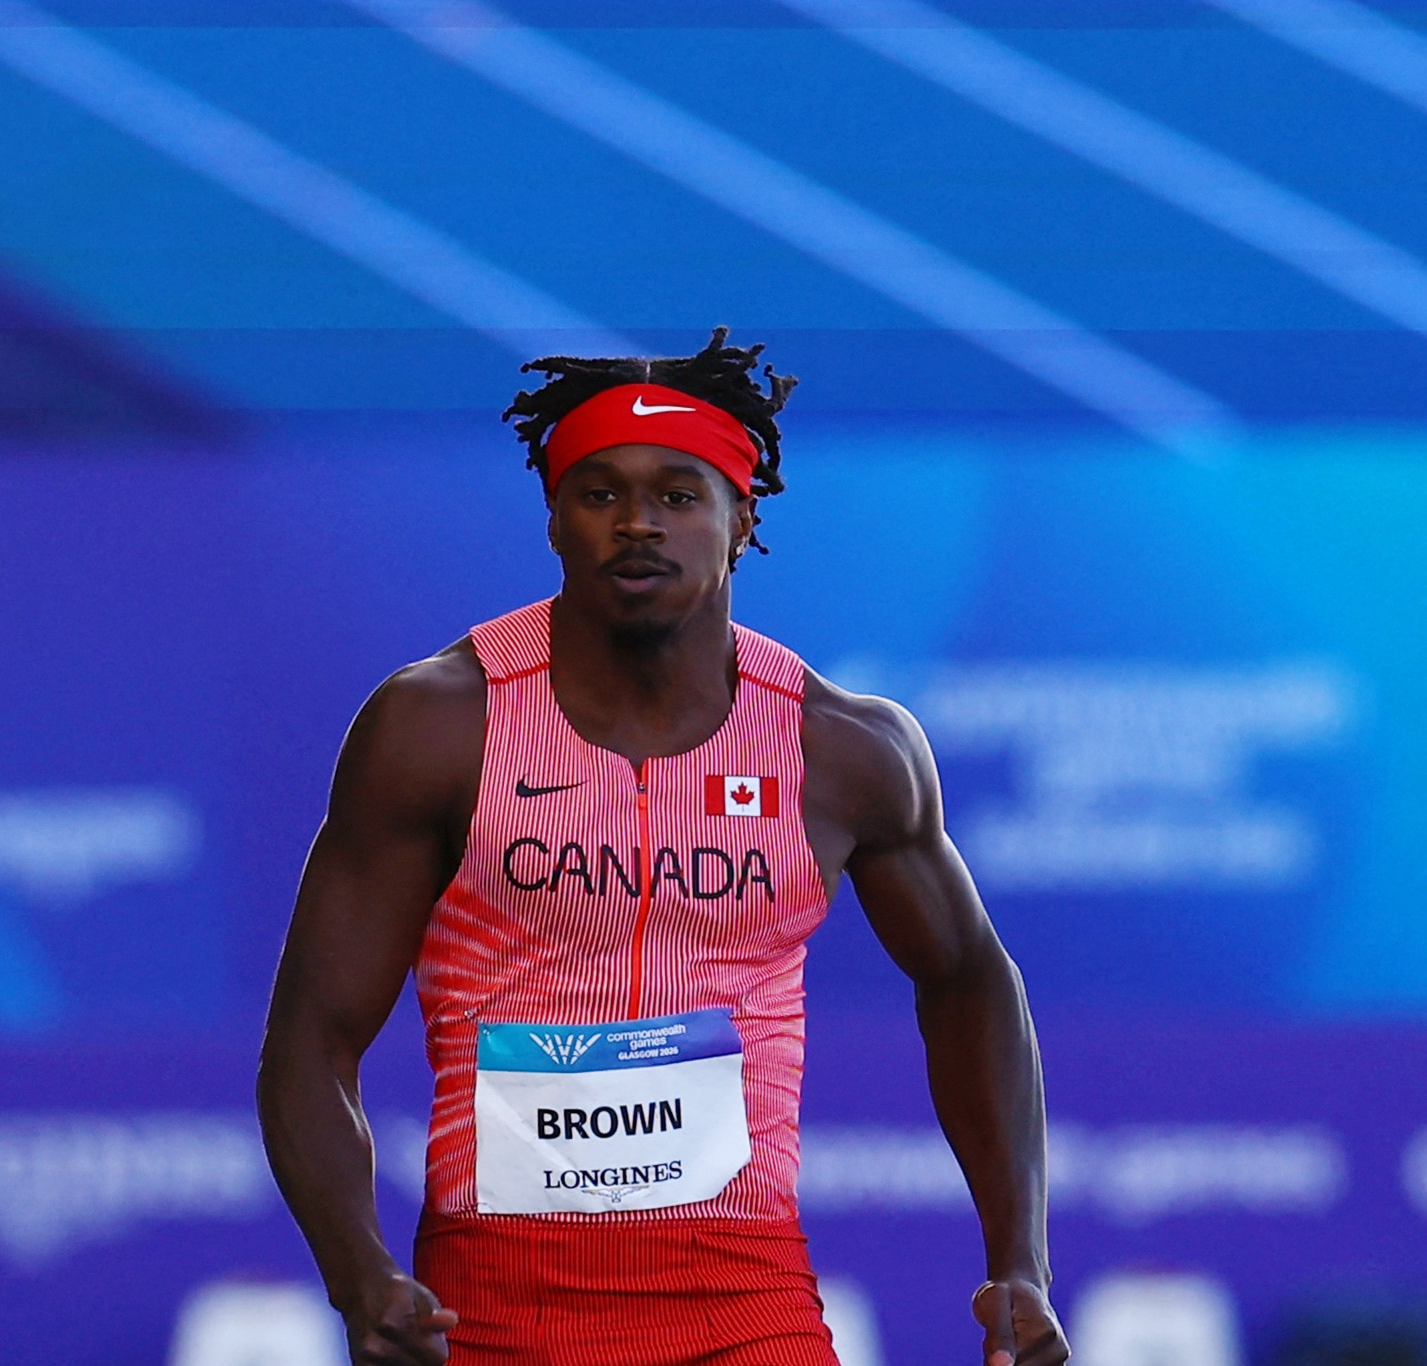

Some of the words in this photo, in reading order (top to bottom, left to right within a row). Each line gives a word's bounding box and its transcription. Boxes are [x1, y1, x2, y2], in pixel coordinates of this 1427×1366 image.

[502, 837, 775, 902] CANADA
[606, 1023, 687, 1043] commonwealth
[629, 1036, 668, 1052] games
[617, 1049, 659, 1061] GLASGOW
[659, 1046, 680, 1057] 2026
[536, 1097, 684, 1141] BROWN
[543, 1160, 683, 1190] LONGINES
